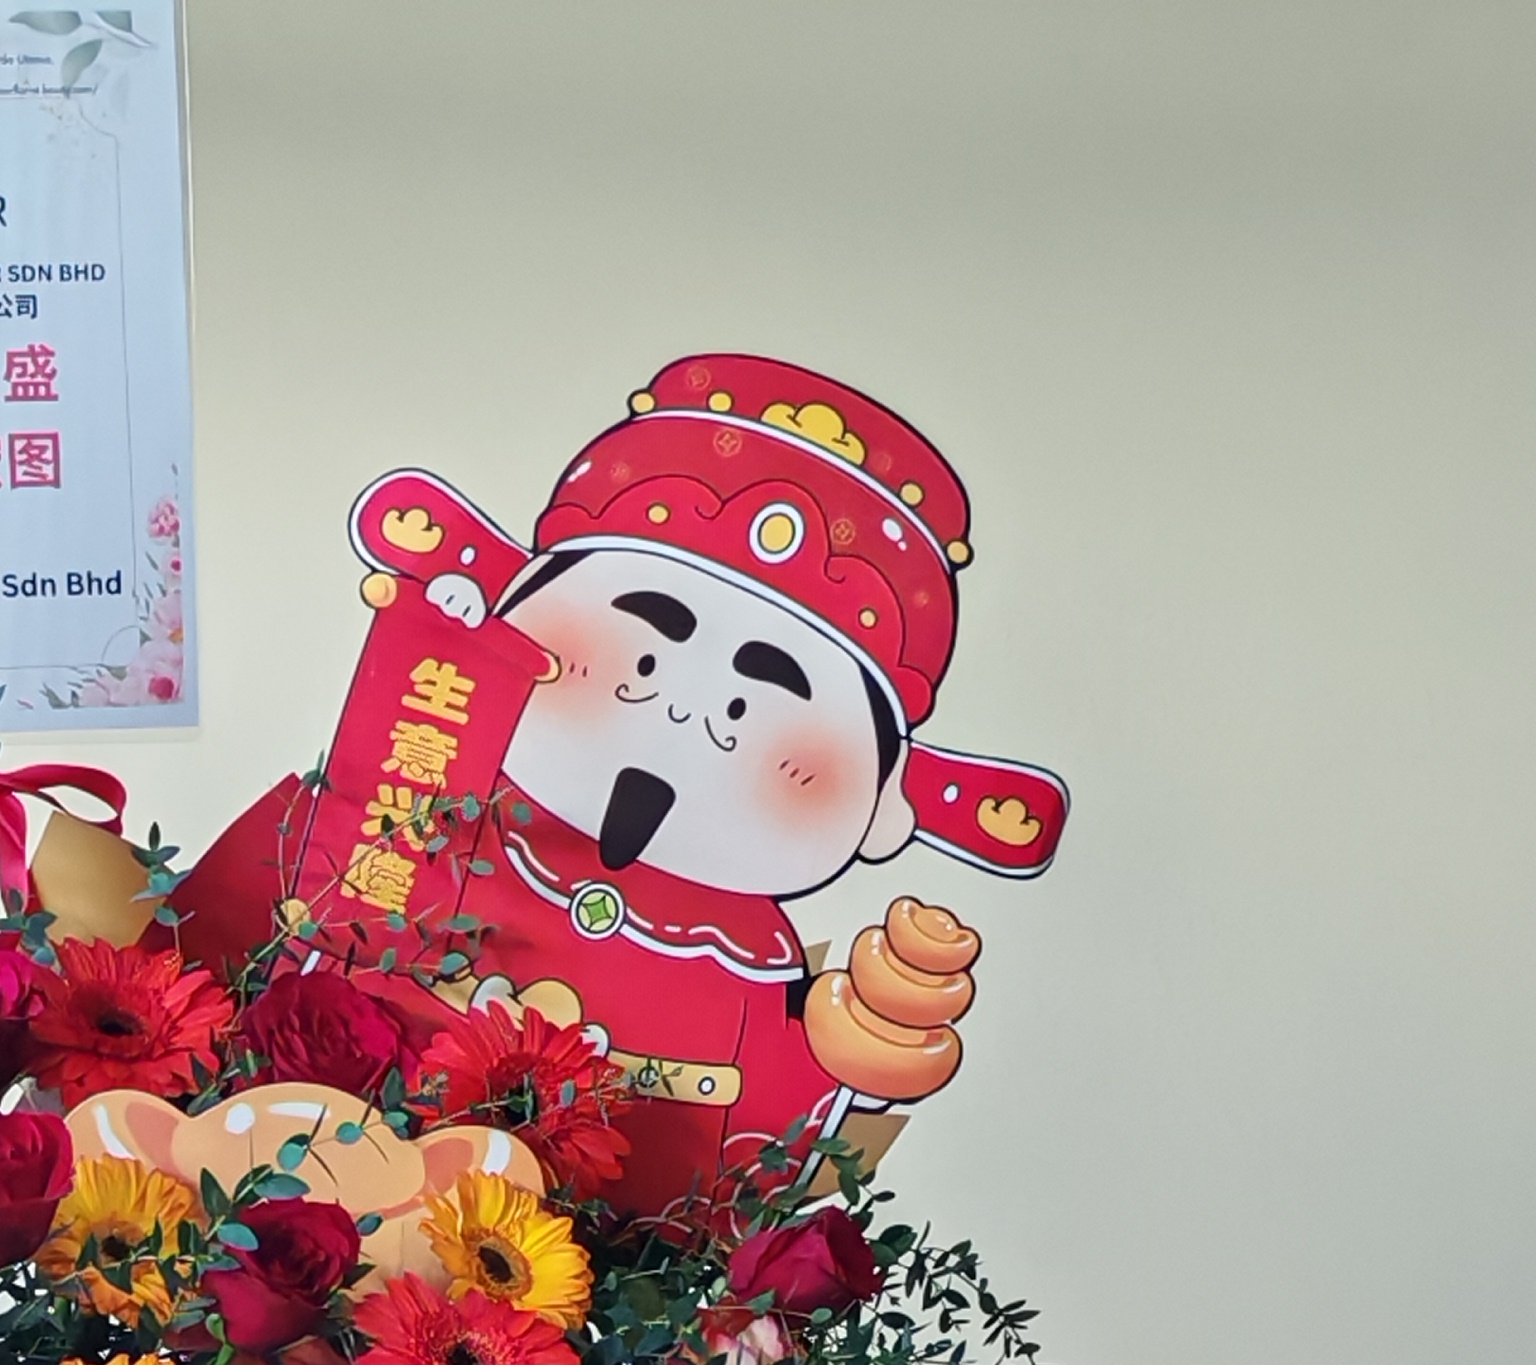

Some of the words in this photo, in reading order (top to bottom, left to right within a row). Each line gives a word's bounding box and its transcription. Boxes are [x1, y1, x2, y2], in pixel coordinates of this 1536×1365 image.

[7, 263, 53, 283] SDN
[58, 262, 106, 282] BHD
[1, 571, 58, 598] Sdn
[65, 569, 123, 597] Bhd
